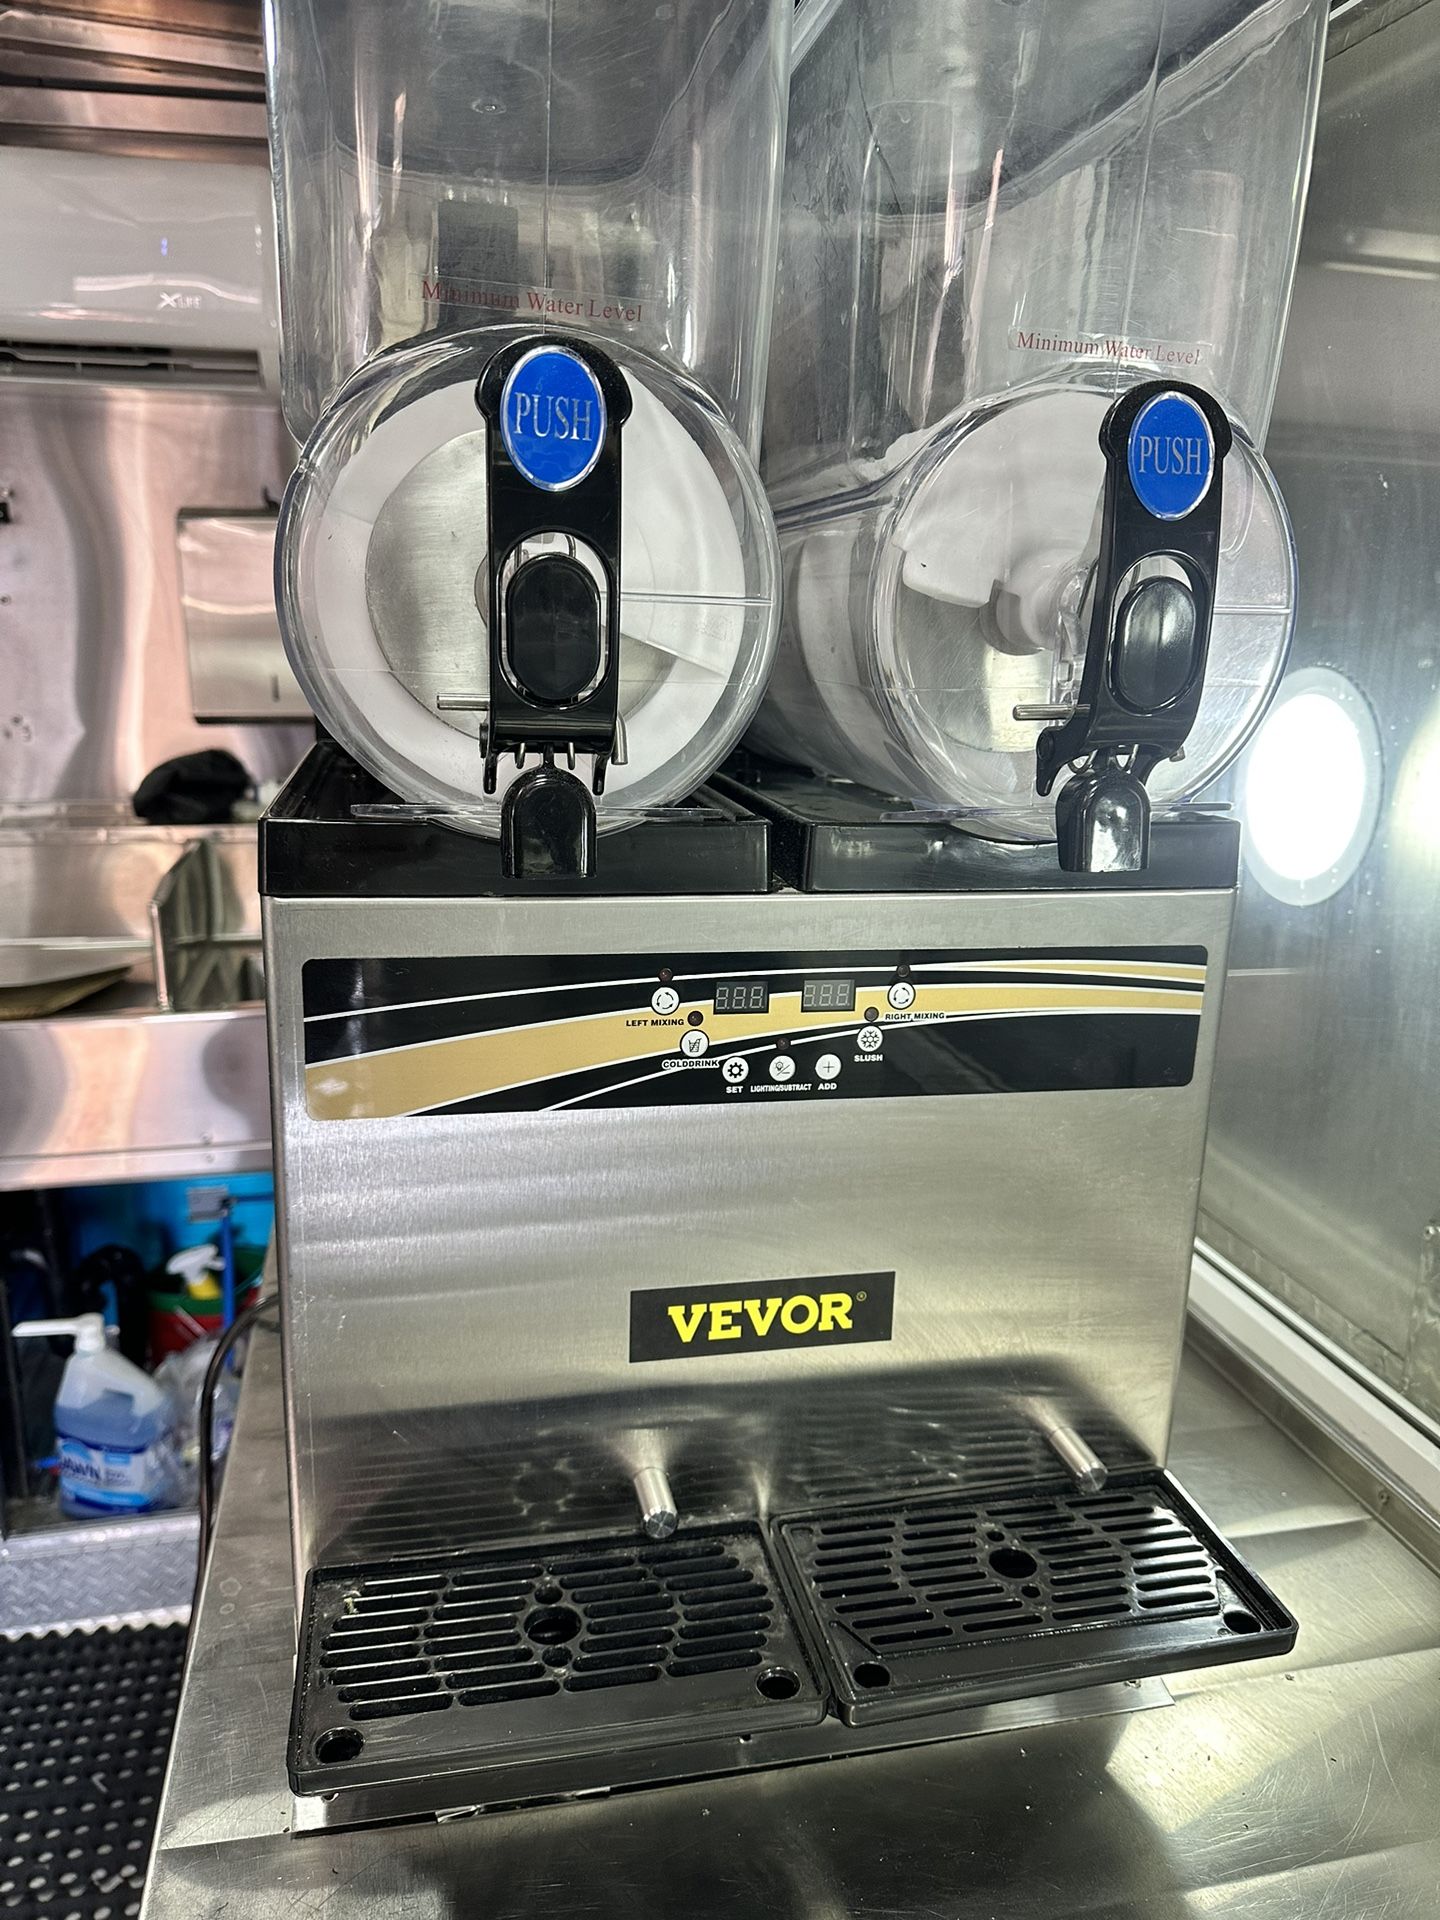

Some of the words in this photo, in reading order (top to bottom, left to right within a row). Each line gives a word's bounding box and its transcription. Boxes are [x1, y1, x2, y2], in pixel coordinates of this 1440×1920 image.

[421, 280, 520, 309] Minimum
[526, 291, 583, 316] Water
[588, 299, 643, 322] Level
[1016, 331, 1099, 355] Minimum
[1105, 339, 1152, 361] Water
[1155, 344, 1201, 366] Level
[513, 391, 593, 442] PUSH
[1138, 435, 1204, 476] PUSH
[884, 1013, 912, 1021] RIGHT
[913, 1012, 945, 1020] MIXING
[625, 1019, 649, 1027] LEFT
[651, 1018, 685, 1027] MIXING
[854, 1053, 884, 1063] SLUSH
[662, 1059, 719, 1069] COLDDRINK
[725, 1085, 744, 1094] SET
[817, 1082, 838, 1091] ADD
